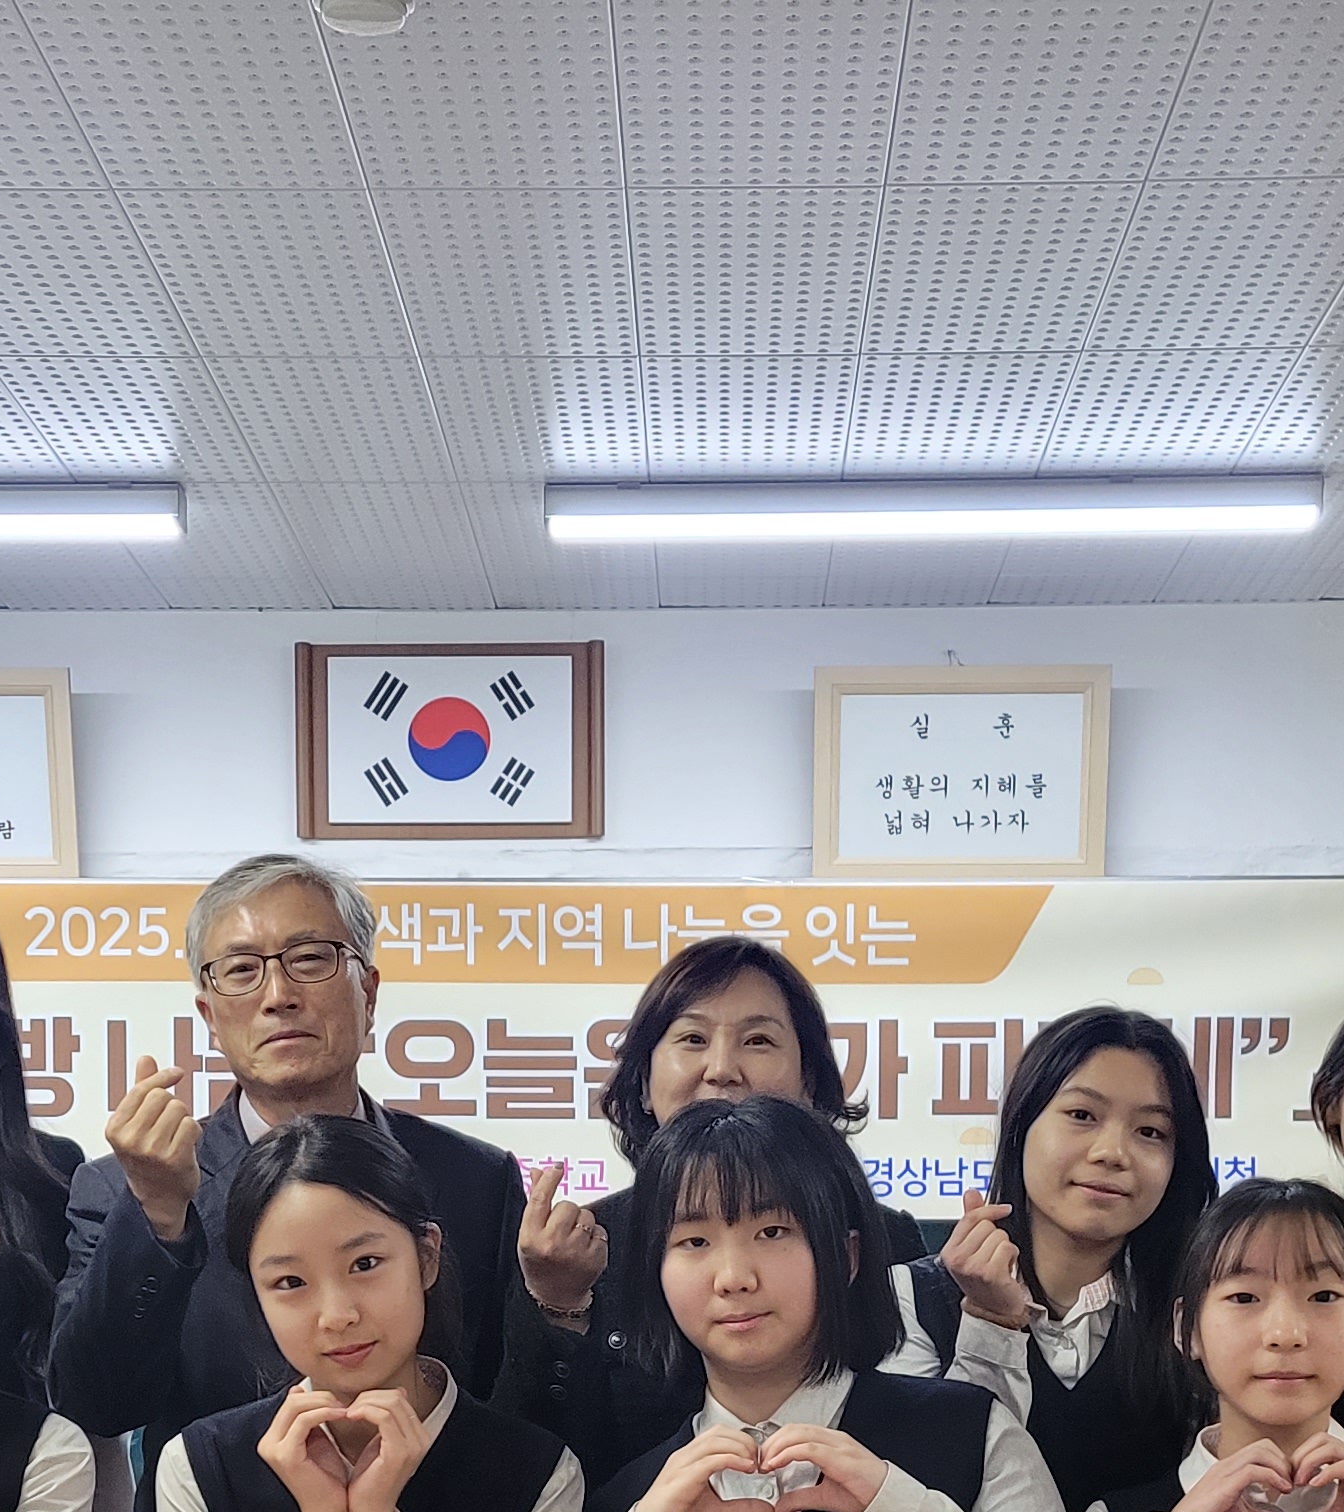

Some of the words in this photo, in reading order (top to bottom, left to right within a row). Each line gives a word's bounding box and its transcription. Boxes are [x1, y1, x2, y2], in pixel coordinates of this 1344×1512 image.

[875, 774, 949, 800] 생활의
[971, 773, 1047, 800] 지혜를
[884, 809, 930, 835] 넓혀
[952, 809, 1030, 835] 나가자
[25, 906, 184, 959] 2025.
[497, 903, 602, 966] 지역
[806, 903, 916, 966] 잇는
